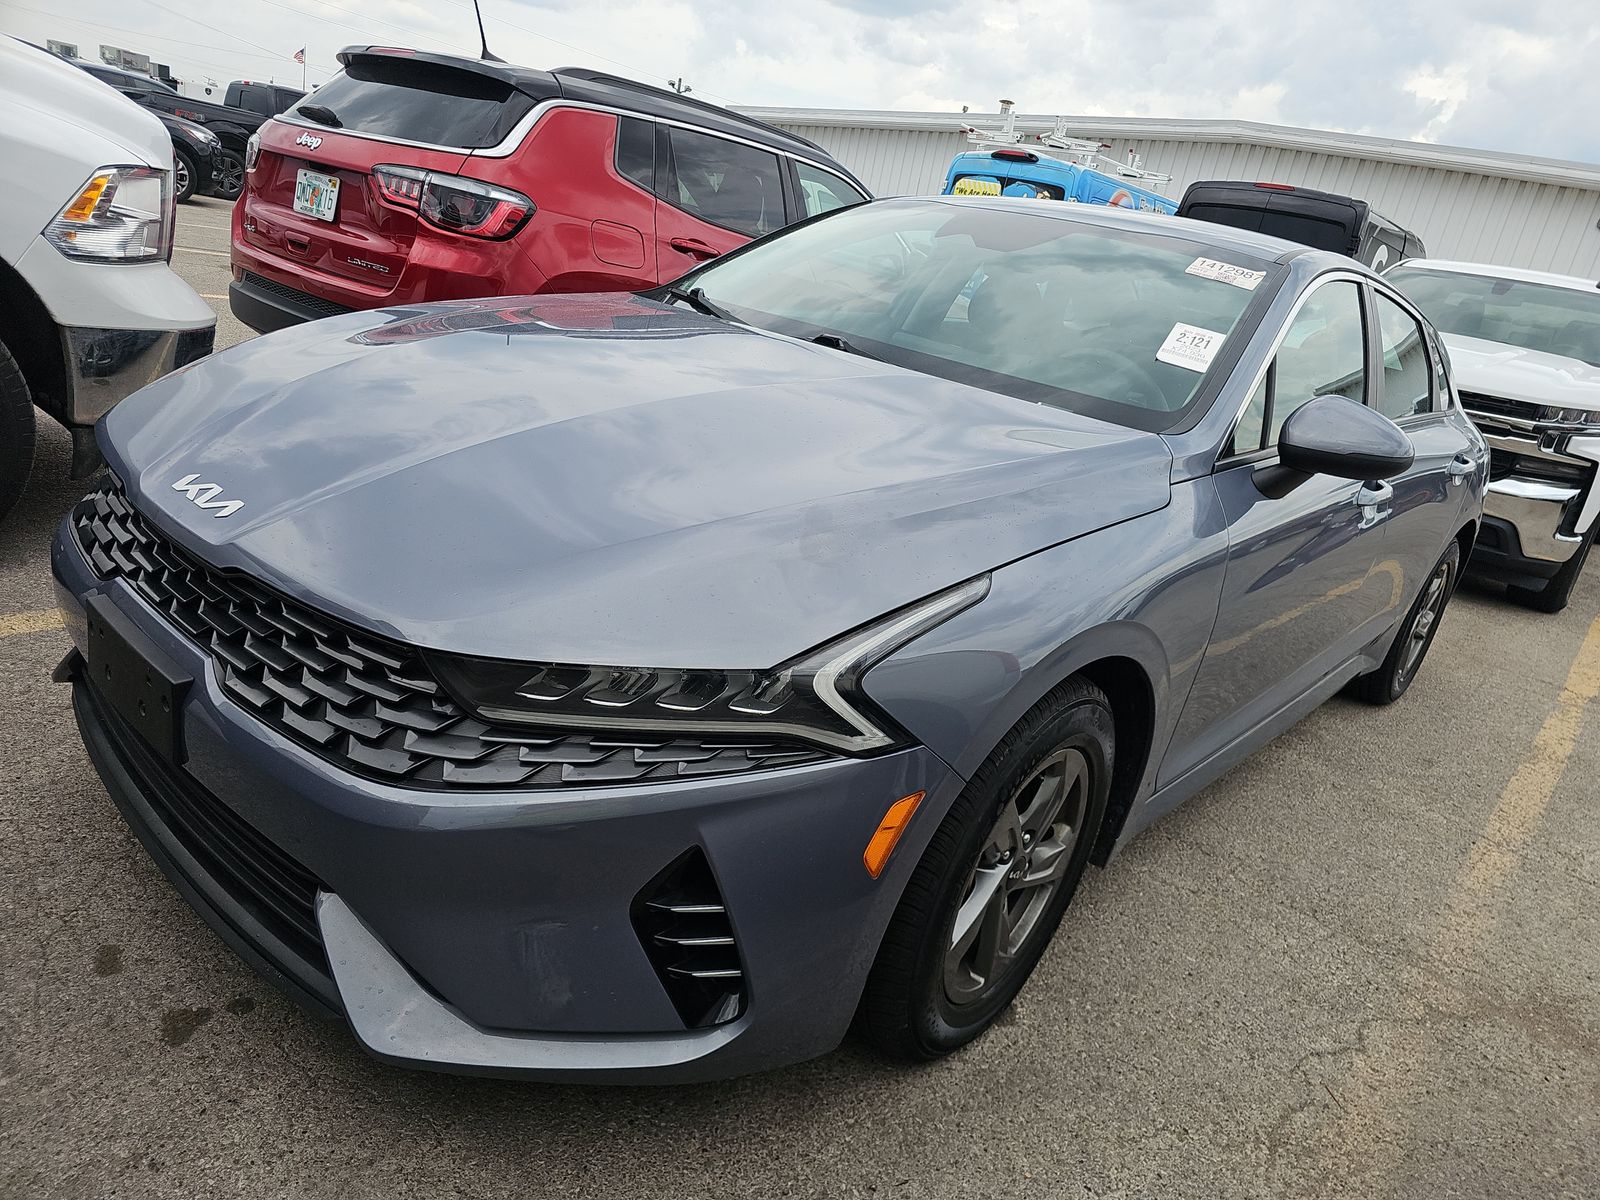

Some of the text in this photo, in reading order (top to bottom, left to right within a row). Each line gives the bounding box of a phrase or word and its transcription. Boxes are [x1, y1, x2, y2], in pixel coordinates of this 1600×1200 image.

[296, 132, 323, 151] Jeep
[1200, 259, 1264, 281] 1412987
[171, 473, 245, 518] KIA
